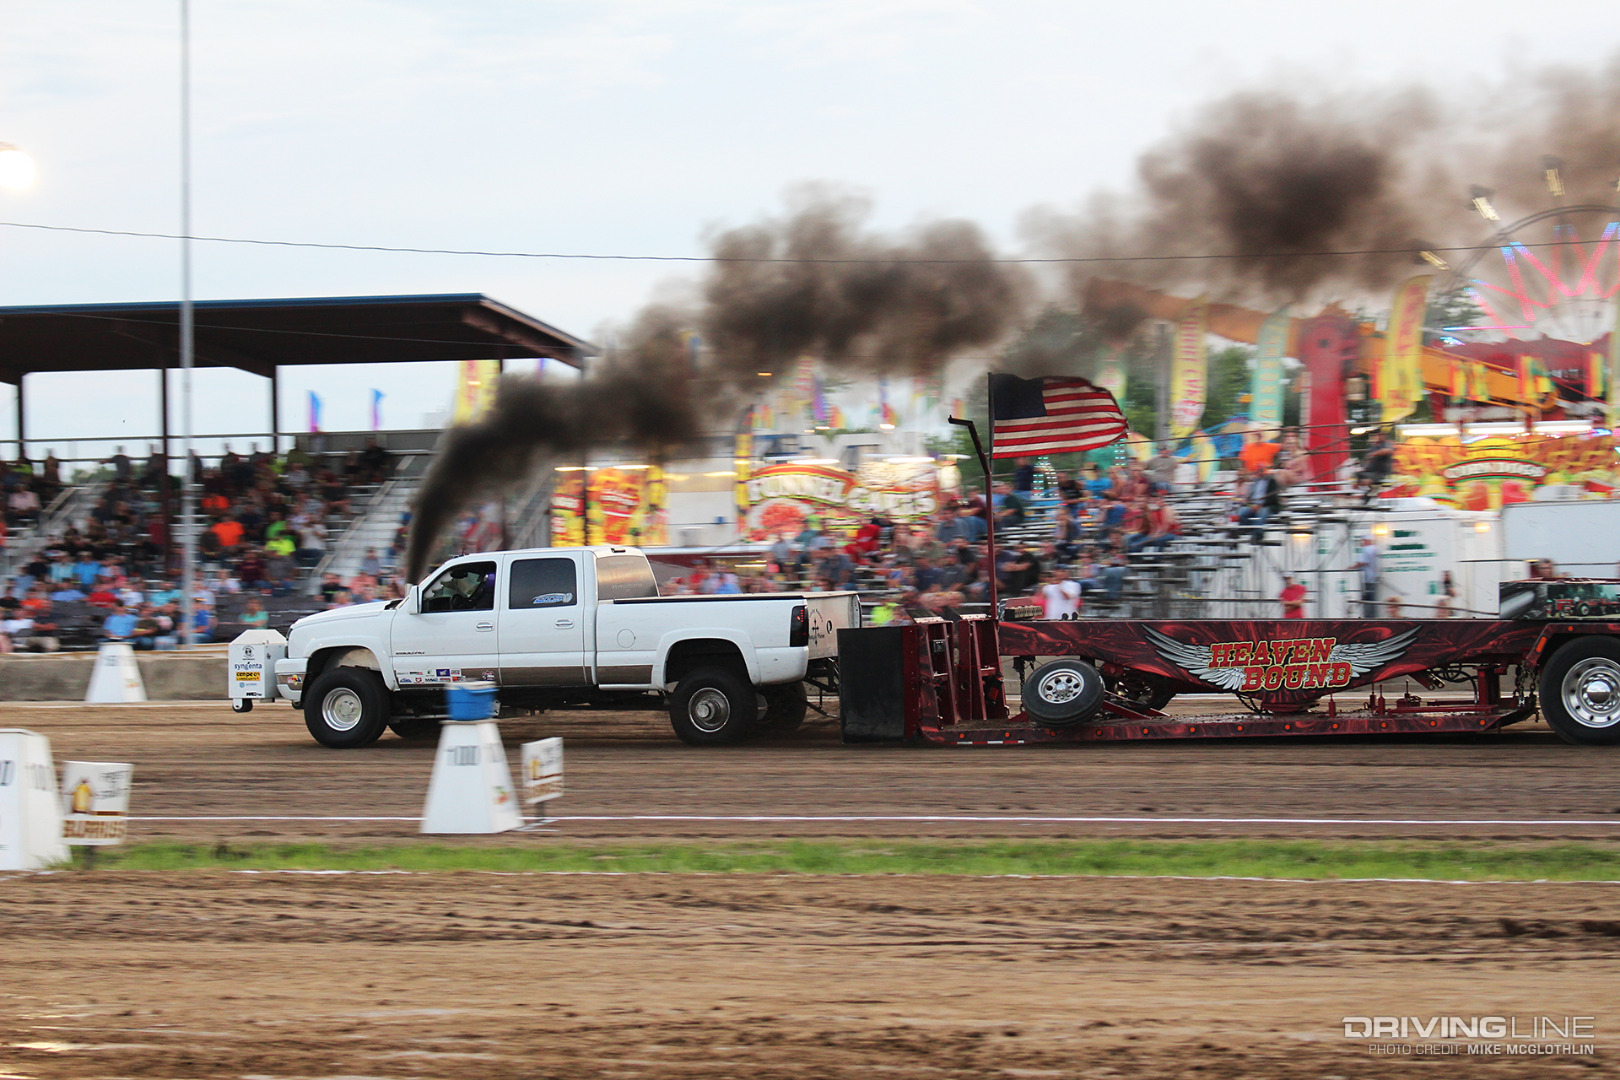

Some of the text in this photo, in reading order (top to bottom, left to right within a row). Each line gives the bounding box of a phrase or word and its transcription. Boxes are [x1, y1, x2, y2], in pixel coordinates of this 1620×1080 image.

[234, 662, 262, 670] syngenta
[1208, 637, 1336, 668] HEAVEN
[1240, 661, 1352, 691] BOUND
